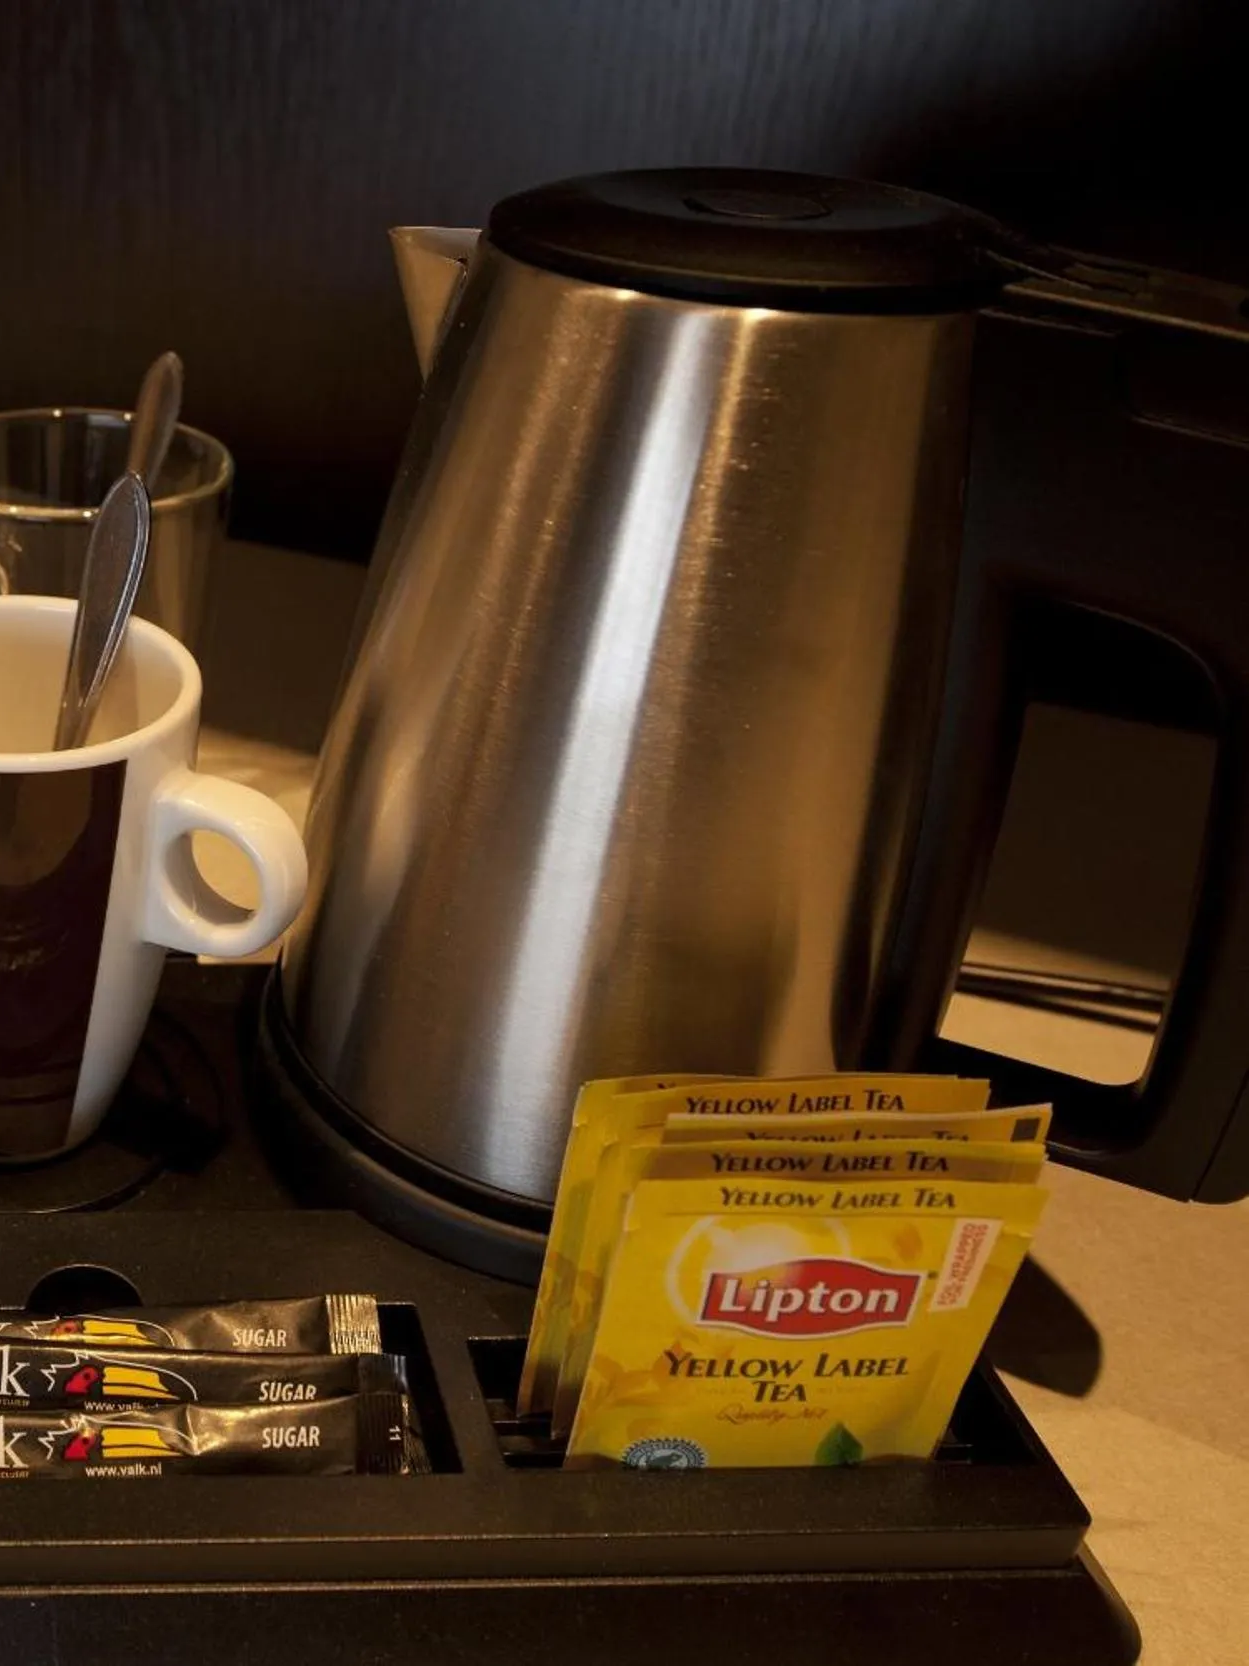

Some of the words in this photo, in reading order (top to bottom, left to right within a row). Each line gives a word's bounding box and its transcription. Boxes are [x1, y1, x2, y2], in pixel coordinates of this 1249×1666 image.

[686, 1097, 779, 1114] YELLOW
[788, 1093, 854, 1114] LABEL
[863, 1089, 905, 1111] TEA
[711, 1153, 814, 1172] YELLOW
[822, 1153, 894, 1172] LABEL
[906, 1151, 950, 1172] TEA
[719, 1186, 824, 1207] YELLOW
[831, 1190, 903, 1209] LABEL
[913, 1188, 956, 1208] TEA
[719, 1278, 900, 1322] Lipton
[233, 1328, 287, 1347] SUGAR
[664, 1349, 804, 1378] YELLOW
[813, 1352, 910, 1378] LABEL
[258, 1381, 317, 1402] SUGAR
[751, 1379, 807, 1402] TEA
[262, 1426, 320, 1448] SUGAR
[85, 1462, 162, 1477] www.valk.nl
